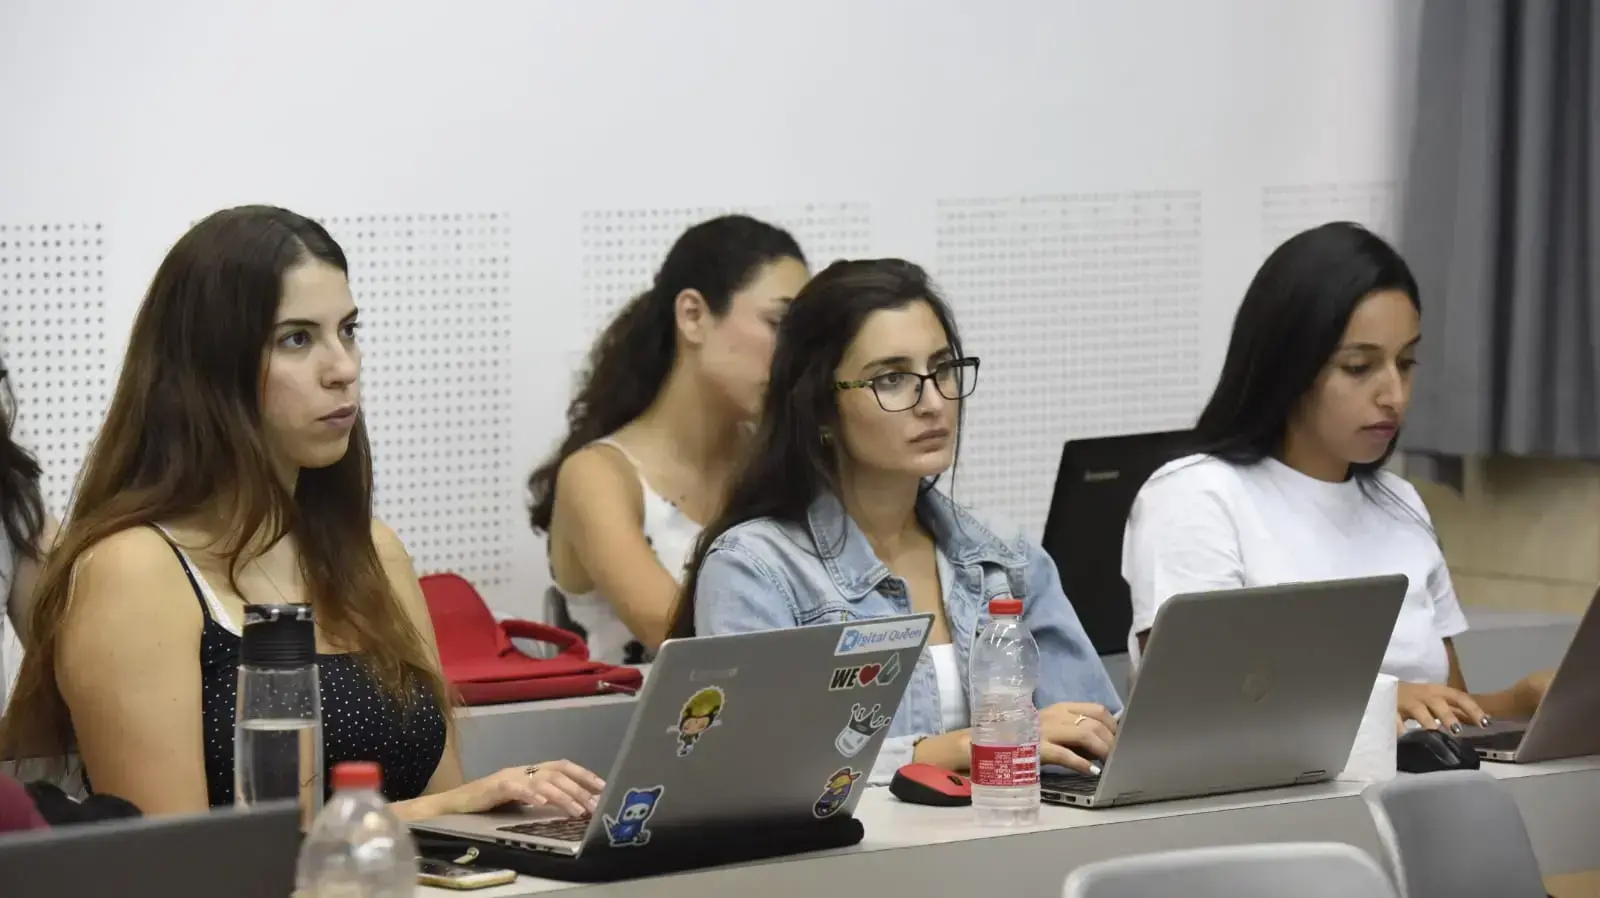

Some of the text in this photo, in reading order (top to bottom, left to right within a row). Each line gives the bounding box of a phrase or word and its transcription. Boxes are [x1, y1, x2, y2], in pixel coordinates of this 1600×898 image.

[839, 628, 922, 653] Digital Queen
[830, 668, 860, 689] WE
